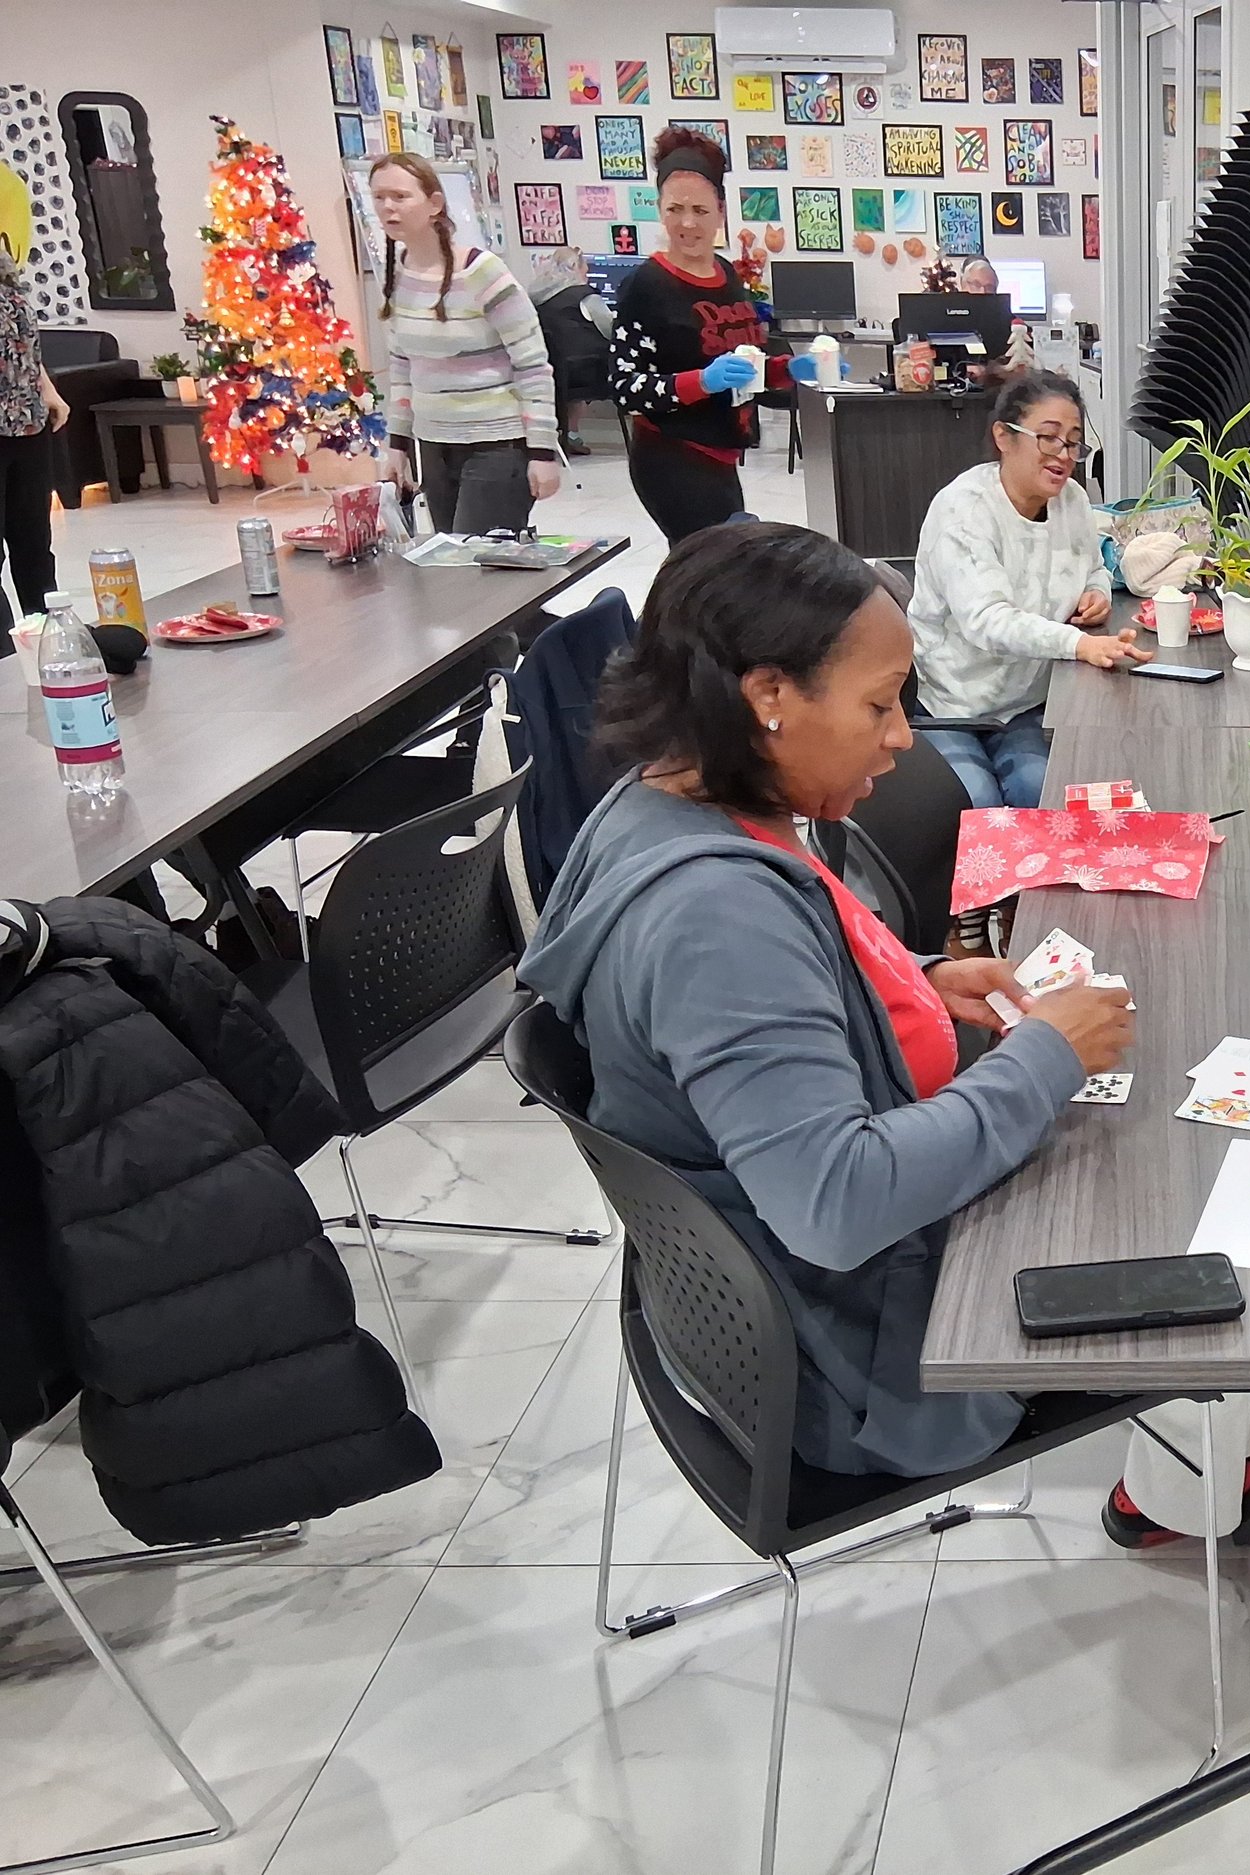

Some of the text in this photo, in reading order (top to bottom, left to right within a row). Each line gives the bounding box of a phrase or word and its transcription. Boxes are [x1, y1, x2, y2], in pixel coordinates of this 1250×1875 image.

[500, 37, 535, 51] SHARE
[686, 58, 712, 76] NOT
[939, 54, 965, 67] ABOUT
[921, 69, 966, 84] CHANGING
[673, 75, 714, 95] FACTS
[930, 87, 956, 98] ME
[787, 95, 841, 123] EXCUSES
[604, 129, 636, 140] MANY
[902, 129, 937, 141] HAVING
[1007, 123, 1048, 145] CLEAN
[622, 138, 629, 146] A
[1008, 143, 1036, 155] AND
[890, 140, 942, 159] SPIRITUAL
[603, 156, 643, 169] NEVER
[886, 156, 942, 175] AWAKENING
[603, 168, 643, 177] ENOUGH
[525, 187, 556, 200] LIFE
[813, 192, 838, 205] ONLY
[939, 197, 978, 212] BE KIND
[523, 209, 561, 227] LIFE'S
[808, 207, 838, 223] SICK
[949, 211, 975, 221] SHOW
[941, 220, 979, 234] RESPECT
[525, 229, 563, 244] TERMS
[799, 229, 839, 249] SECRETS
[961, 241, 981, 254] MIND
[946, 308, 970, 316] Lenovo
